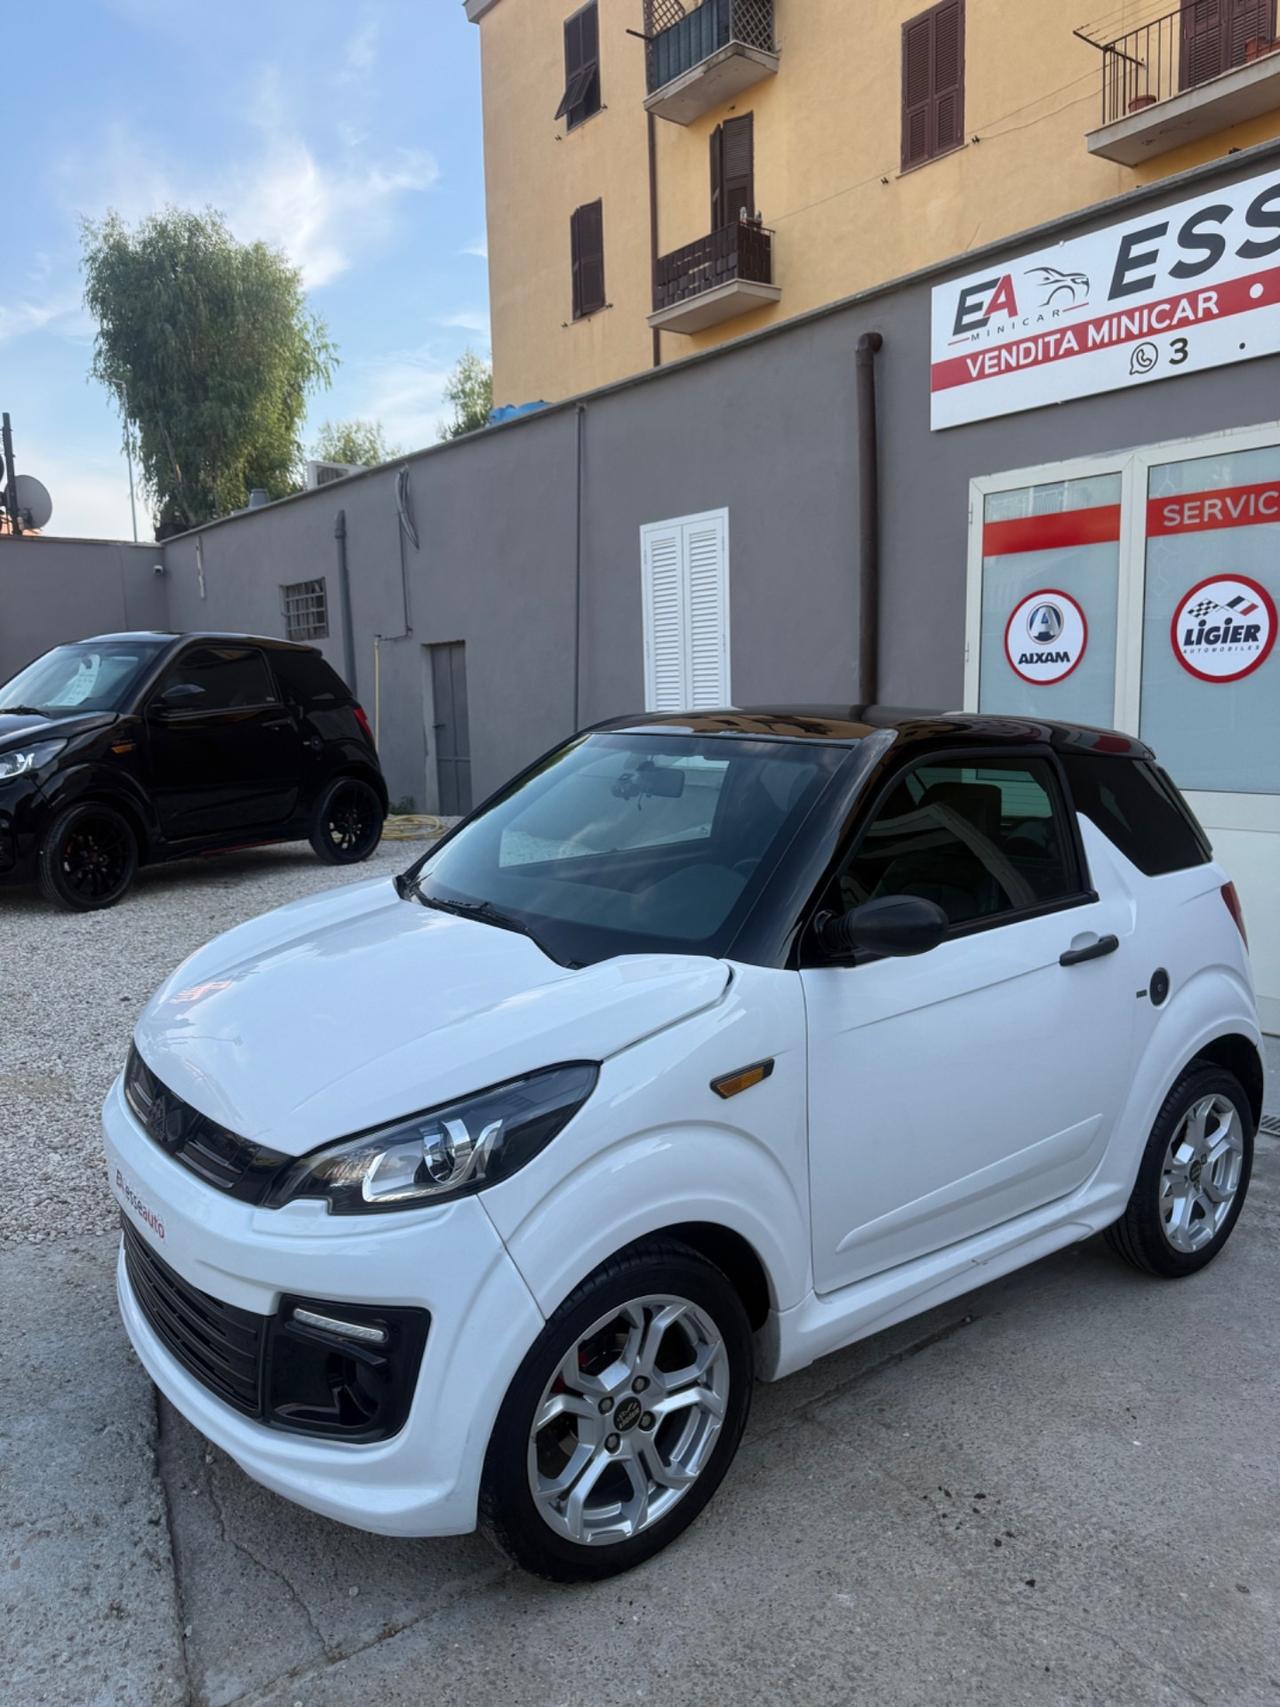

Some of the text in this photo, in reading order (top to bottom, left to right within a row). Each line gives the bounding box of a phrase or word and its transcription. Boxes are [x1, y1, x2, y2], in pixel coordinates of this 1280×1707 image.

[952, 273, 1019, 337] EA
[966, 290, 1220, 379] VENDITA MINICAR
[970, 308, 1061, 342] MINICAR
[1168, 337, 1190, 365] 3
[1163, 490, 1280, 527] SERVIC
[1018, 650, 1071, 665] AIXAM
